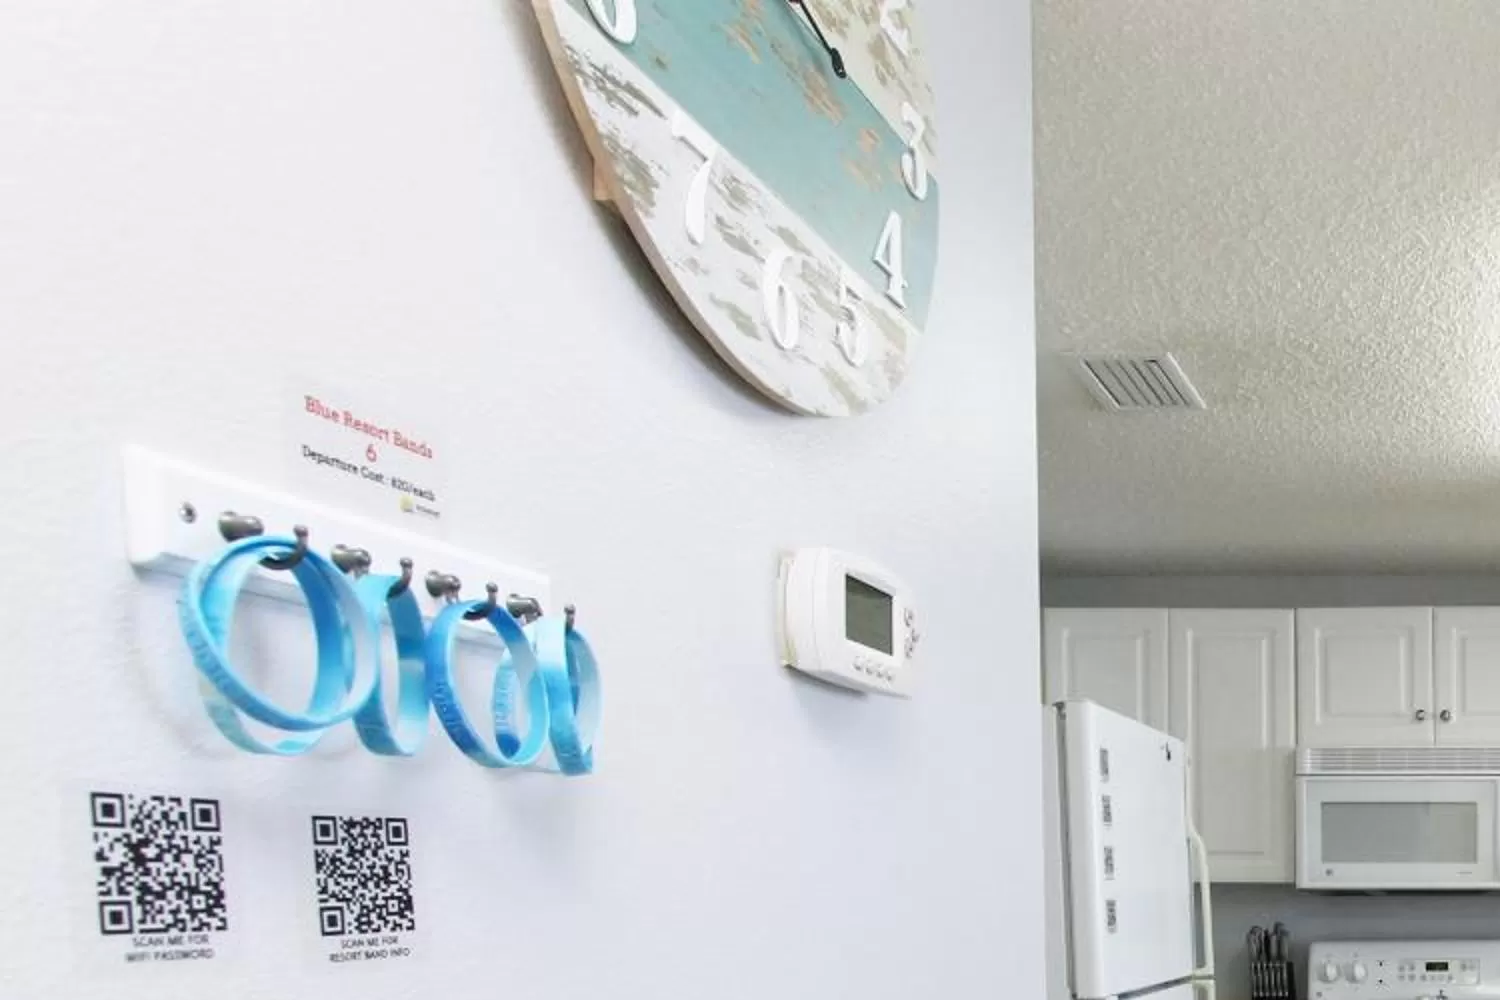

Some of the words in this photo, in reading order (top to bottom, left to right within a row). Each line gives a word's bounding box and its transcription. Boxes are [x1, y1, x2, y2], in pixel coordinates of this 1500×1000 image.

[671, 107, 717, 245] 7
[901, 102, 927, 201] 3
[872, 210, 908, 309] 4
[762, 249, 799, 350] 6
[833, 275, 868, 367] 5
[304, 395, 340, 424] Blue
[343, 411, 390, 442] Resort
[392, 430, 434, 459] Bands
[366, 444, 377, 463] 6
[302, 444, 359, 475] Departure
[132, 936, 164, 947] SCAN
[167, 935, 184, 945] ME
[187, 934, 210, 945] FOR
[329, 950, 361, 963] RESORT
[341, 939, 365, 950] SCAN
[366, 937, 379, 947] ME
[382, 936, 399, 946] FOR
